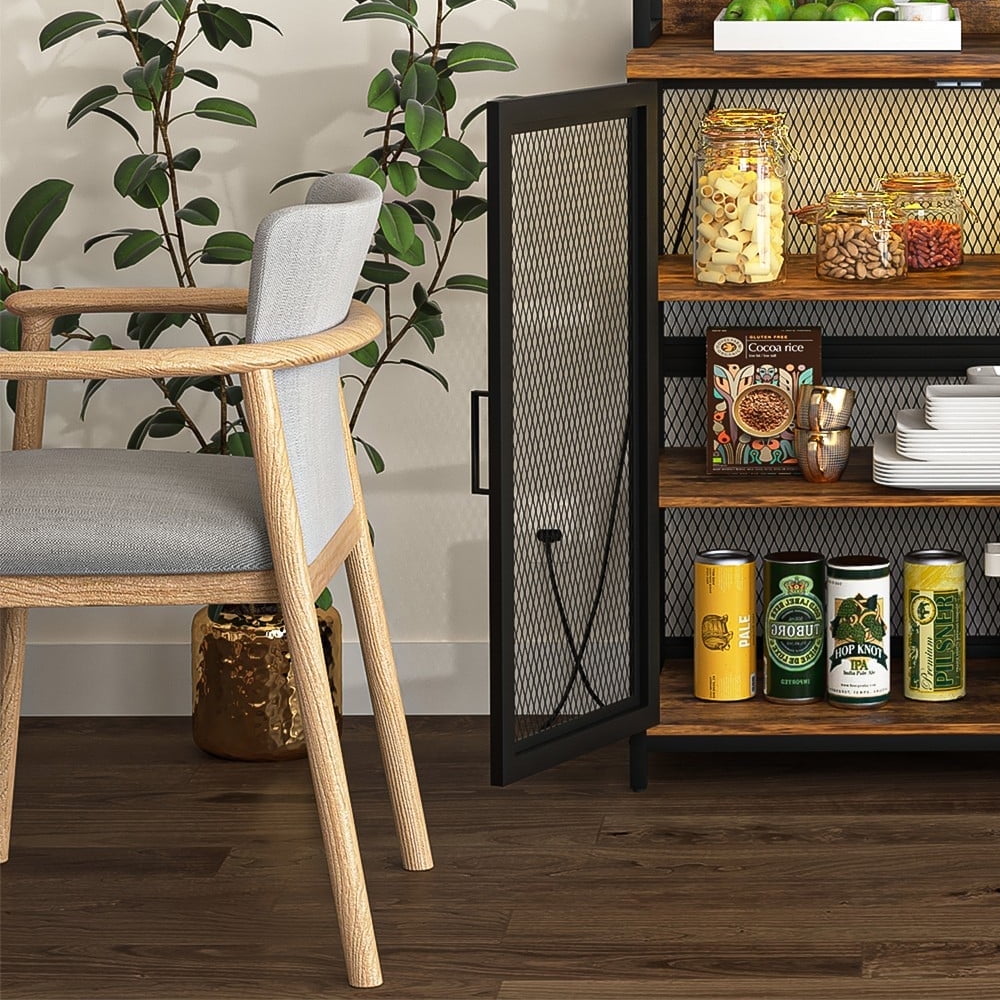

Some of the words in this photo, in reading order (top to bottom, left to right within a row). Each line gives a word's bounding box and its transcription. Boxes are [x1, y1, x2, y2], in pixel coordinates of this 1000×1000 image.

[748, 342, 782, 352] Cocoa
[785, 342, 804, 352] rice
[739, 615, 750, 648] PALE
[935, 595, 955, 687] PILSNER
[835, 644, 855, 659] HOP
[857, 643, 882, 659] KNOT
[850, 659, 868, 670] IPA
[920, 636, 934, 691] Premium
